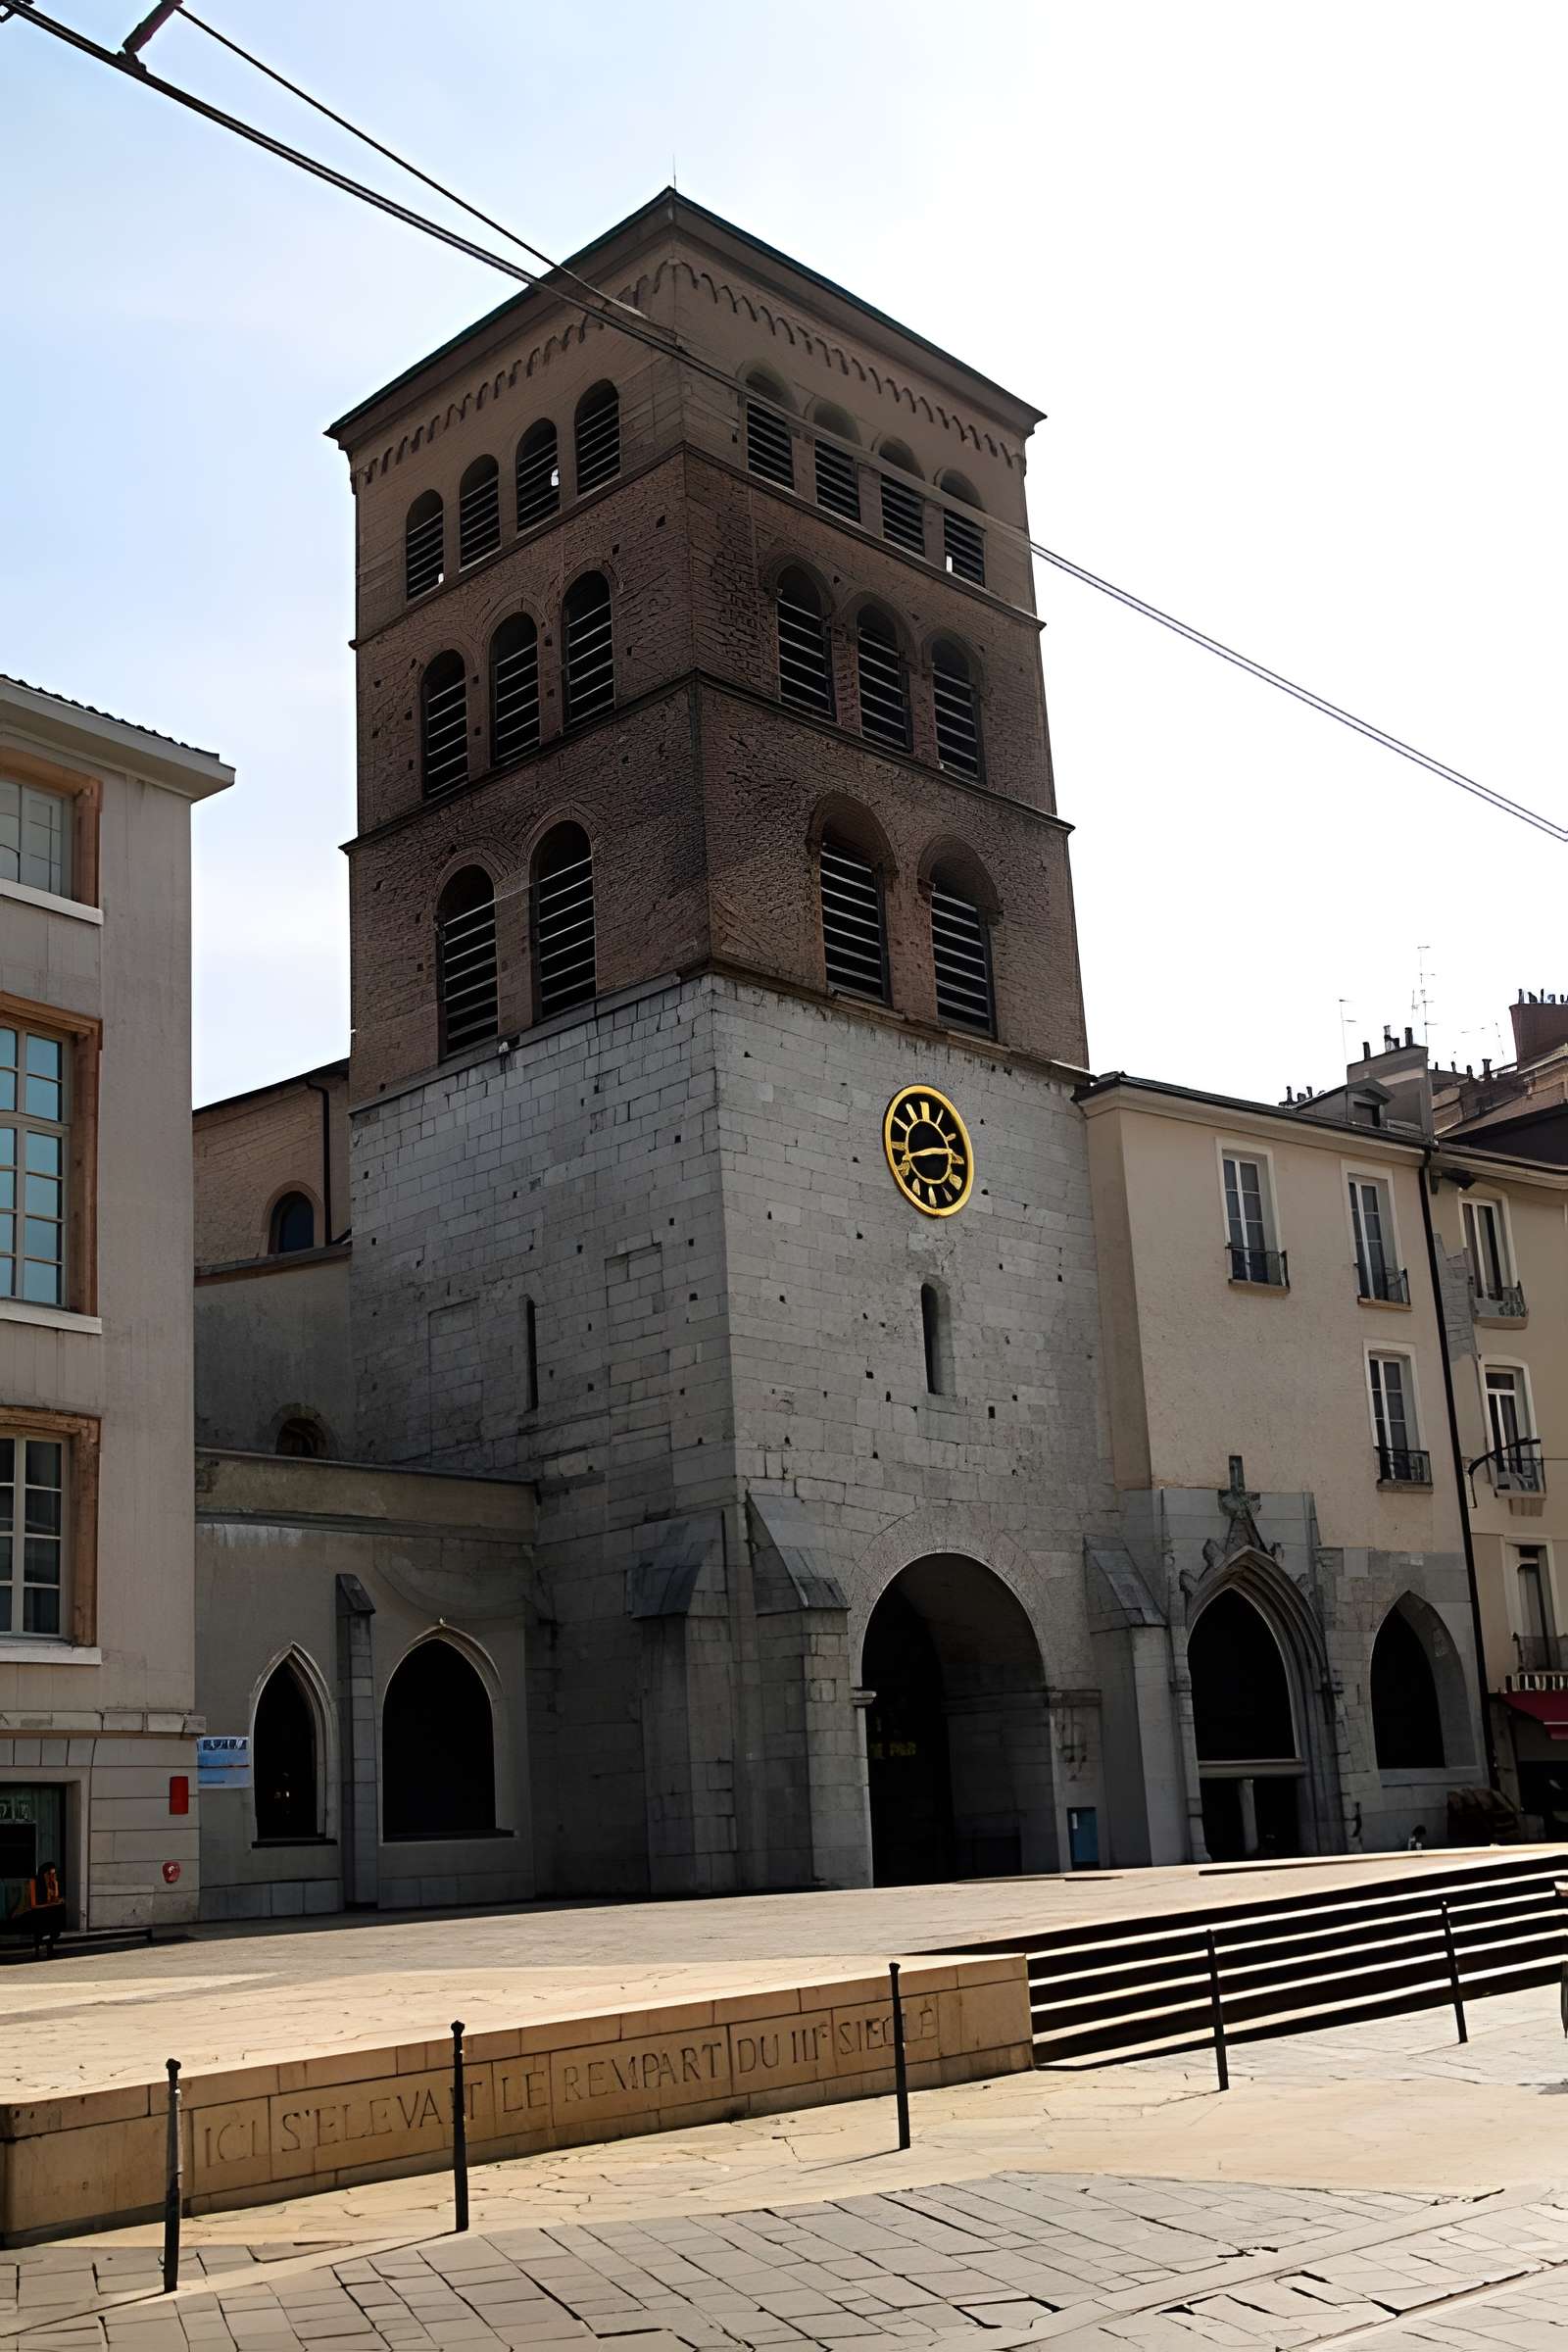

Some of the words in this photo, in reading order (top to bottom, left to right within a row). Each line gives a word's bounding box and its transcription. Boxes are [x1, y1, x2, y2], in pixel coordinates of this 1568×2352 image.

[204, 2120, 257, 2168] ICI
[501, 2070, 549, 2114] LE
[564, 2041, 723, 2103] REMPART
[737, 2033, 780, 2074] DU
